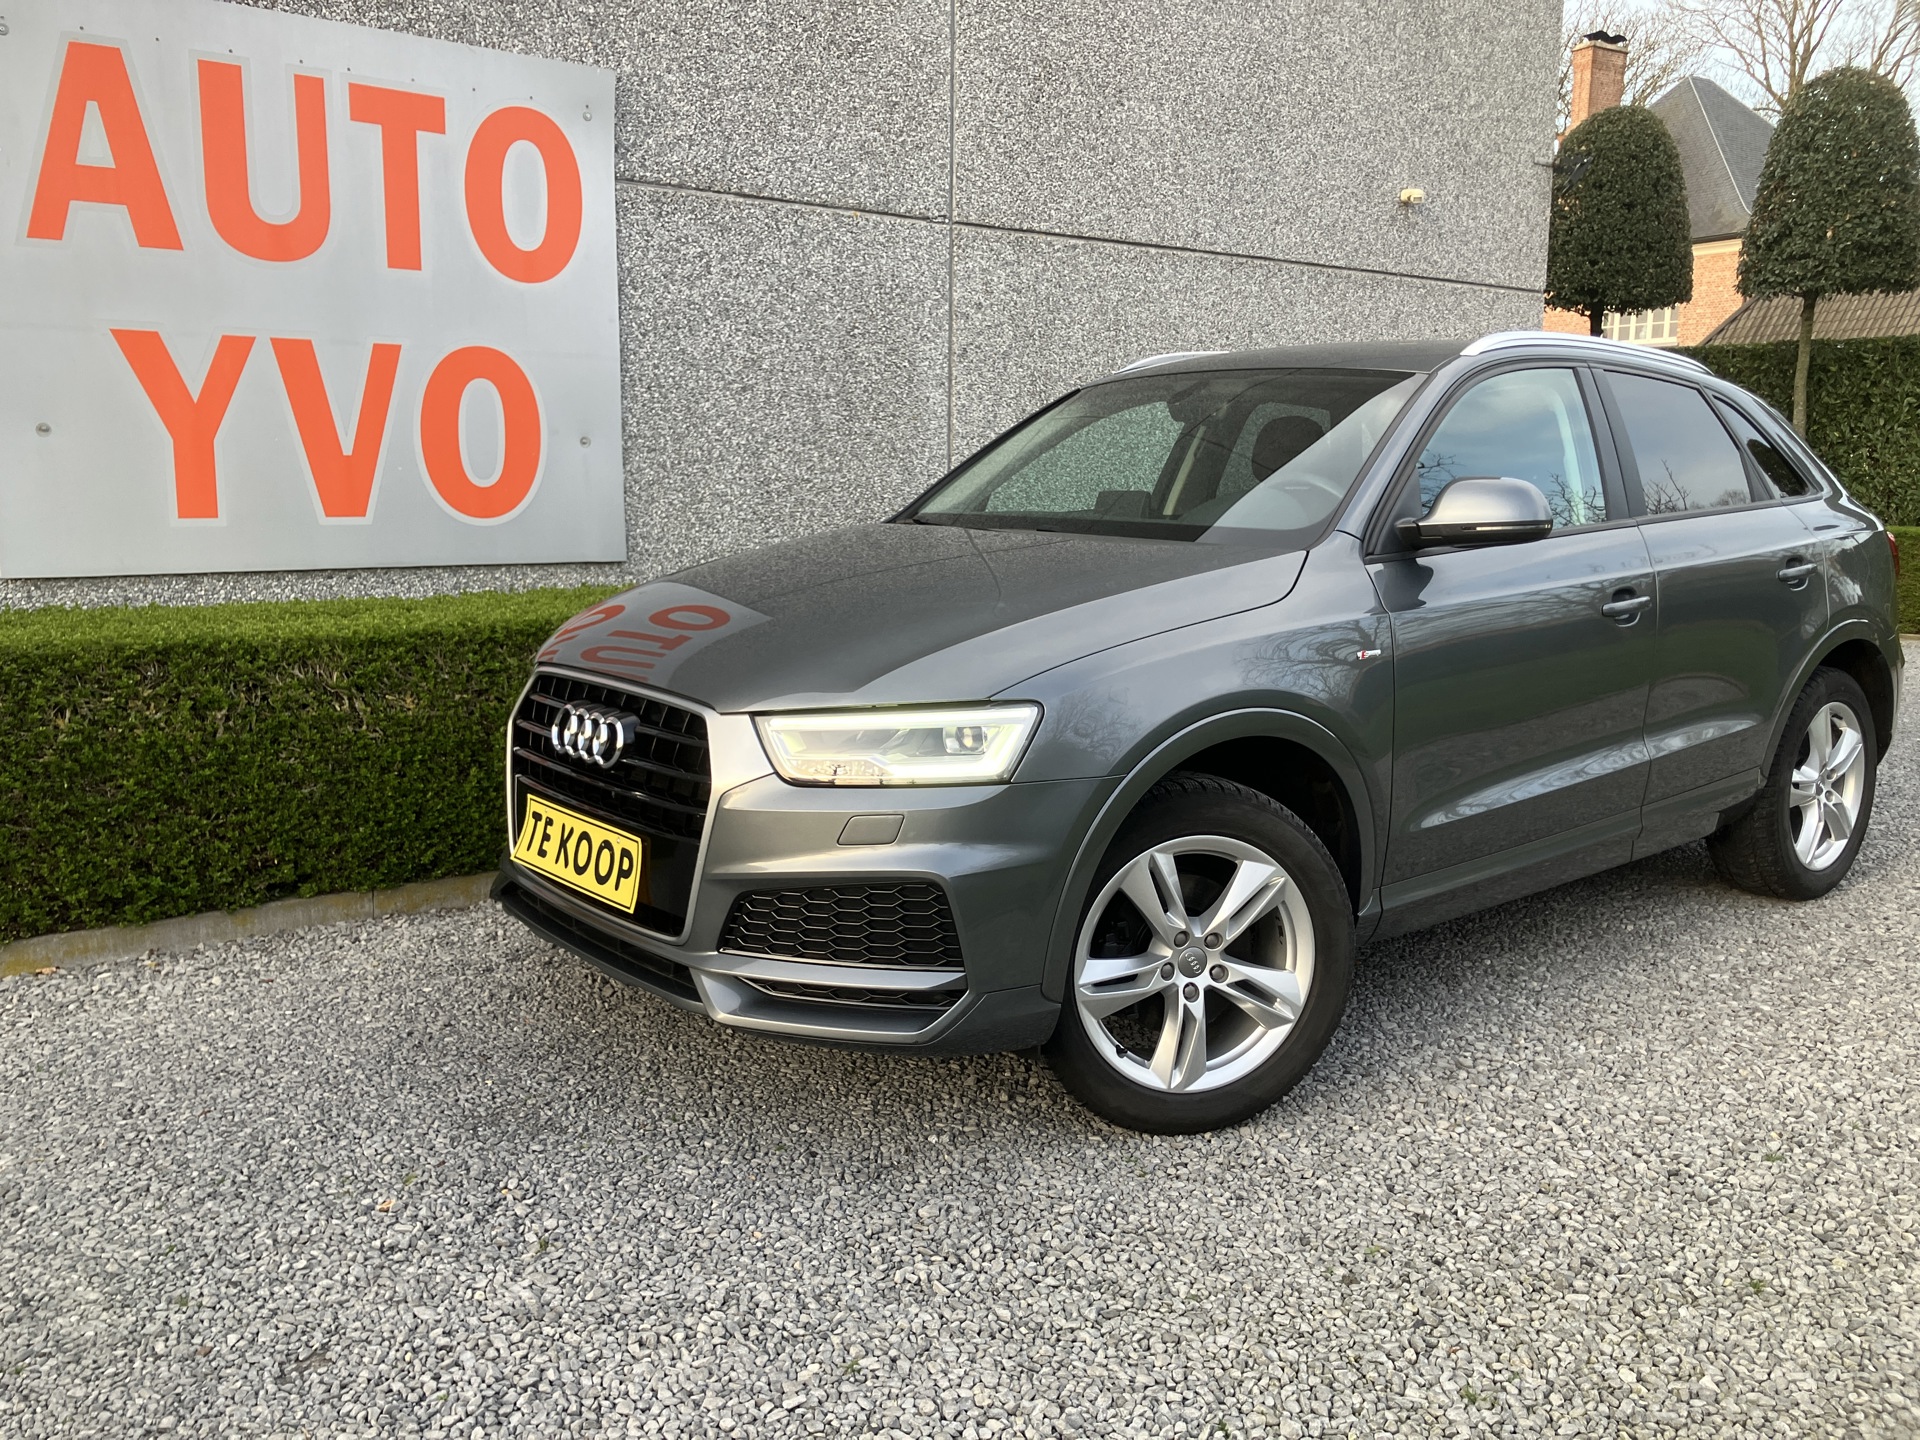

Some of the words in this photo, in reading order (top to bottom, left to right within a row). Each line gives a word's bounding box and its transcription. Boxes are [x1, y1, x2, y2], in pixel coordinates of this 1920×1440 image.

[27, 41, 583, 283] AUTO
[109, 328, 541, 519] YVO
[526, 811, 554, 858] TE
[555, 822, 634, 892] KOOP
